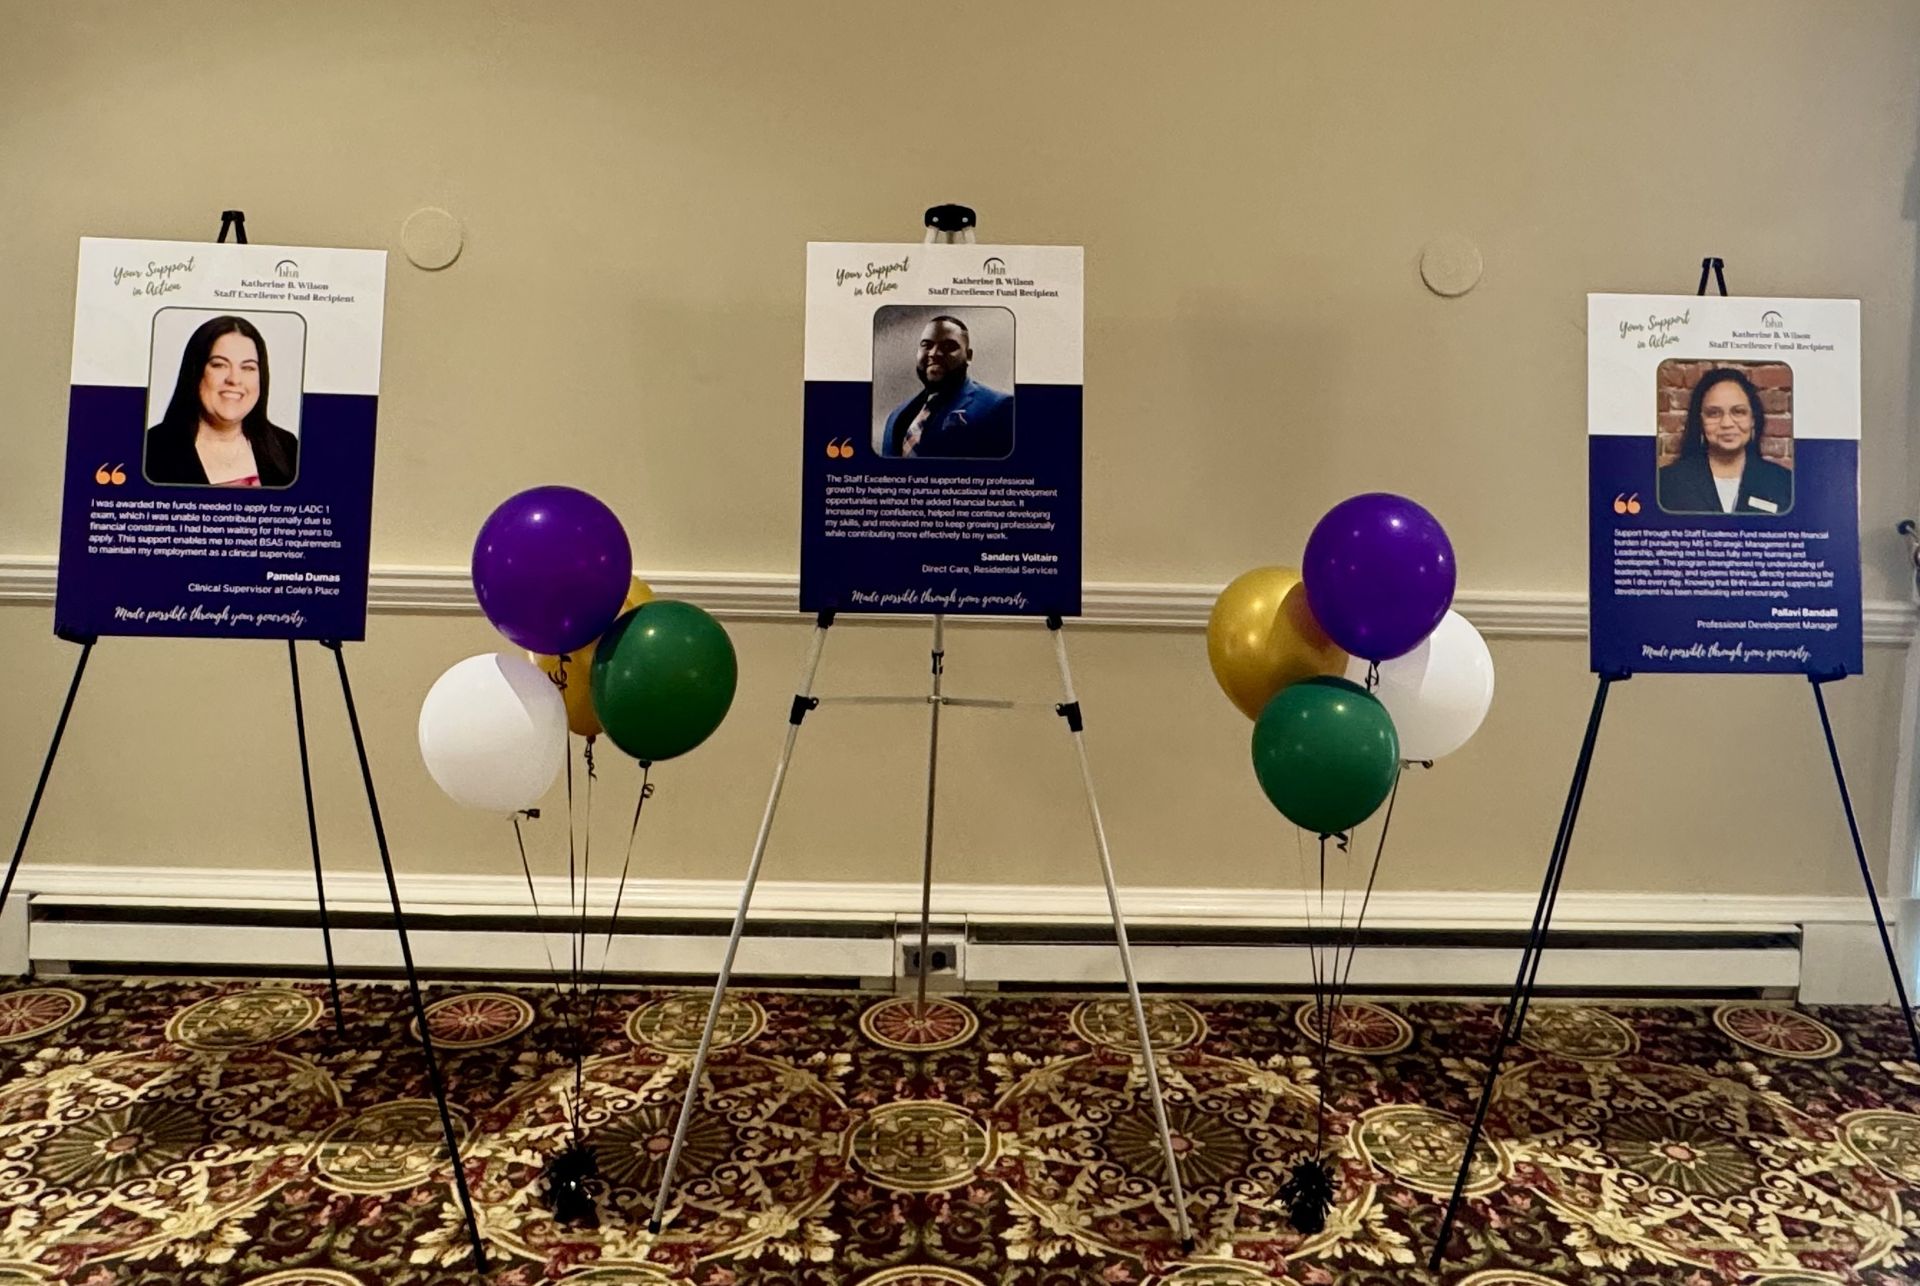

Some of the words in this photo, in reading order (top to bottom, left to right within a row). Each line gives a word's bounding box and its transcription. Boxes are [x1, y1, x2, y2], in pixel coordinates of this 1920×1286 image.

[114, 266, 141, 285] Your
[147, 256, 195, 277] Support
[836, 269, 862, 286] Your
[865, 256, 909, 278] Support
[241, 279, 285, 288] Katherine
[298, 282, 328, 290] Wilson
[854, 287, 863, 296] in
[866, 279, 898, 295] Action
[952, 277, 994, 285] Katherine
[133, 287, 143, 296] in
[145, 281, 181, 295] Action
[928, 287, 949, 295] Staff
[996, 288, 1017, 296] Fund
[1019, 289, 1058, 298] Recipient
[238, 291, 285, 299] Excellence
[312, 294, 354, 303] Recipient
[1620, 321, 1643, 338] Your
[1648, 309, 1690, 330] Support
[1637, 340, 1646, 349] in
[1648, 335, 1680, 348] Action
[1774, 342, 1794, 350] Fund
[1796, 343, 1834, 352] Recipient
[115, 500, 154, 508] awarded
[156, 501, 170, 509] the
[172, 501, 197, 510] funds
[198, 503, 231, 511] needed
[233, 503, 242, 511] to
[244, 504, 267, 513] apply
[269, 504, 281, 512] for
[283, 506, 297, 514] my
[298, 505, 323, 513] LADC
[90, 512, 116, 520] exam,
[119, 512, 145, 520] which
[170, 513, 200, 521] unable
[202, 514, 211, 522] to
[212, 514, 256, 523] contribute
[258, 516, 302, 525] personally
[322, 517, 331, 525] to
[90, 521, 126, 530] financial
[127, 524, 177, 532] constraints.
[184, 524, 201, 533] had
[202, 525, 225, 533] been
[226, 526, 258, 536] waiting
[259, 526, 271, 535] for
[273, 527, 296, 535] three
[298, 529, 321, 537] years
[118, 534, 136, 543] This
[137, 536, 171, 544] support
[172, 536, 207, 544] enables
[235, 538, 257, 546] meet
[259, 537, 283, 546] BSAS
[284, 540, 341, 548] requirements
[88, 545, 98, 553] to
[99, 546, 136, 554] maintain
[138, 547, 151, 556] my
[153, 548, 207, 557] employment
[228, 549, 257, 557] clinical
[981, 552, 1020, 561] Sanders
[1022, 553, 1057, 562] Voltaire
[922, 564, 946, 573] Direct
[948, 565, 971, 574] Care,
[973, 565, 1019, 573] Residential
[1021, 566, 1057, 574] Services
[266, 571, 303, 581] Pamela
[304, 572, 340, 582] Dumas
[188, 583, 221, 592] Clinical
[222, 584, 272, 593] Supervisor
[274, 586, 283, 594] at
[285, 585, 312, 594] Cole's
[314, 586, 339, 595] Place
[851, 590, 878, 603] Made
[880, 589, 918, 605] possible
[920, 589, 956, 606] through
[958, 595, 980, 608] your
[114, 606, 145, 620] Made
[145, 606, 187, 622] possible
[189, 606, 229, 624] through
[230, 613, 254, 626] your
[1771, 608, 1801, 616] Pallavi
[1697, 620, 1746, 628] Professional
[1747, 620, 1800, 629] Development
[1802, 621, 1838, 631] Manager
[1642, 645, 1668, 658] Made
[1669, 643, 1706, 659] possible
[1707, 643, 1742, 661] through
[1743, 649, 1765, 662] your
